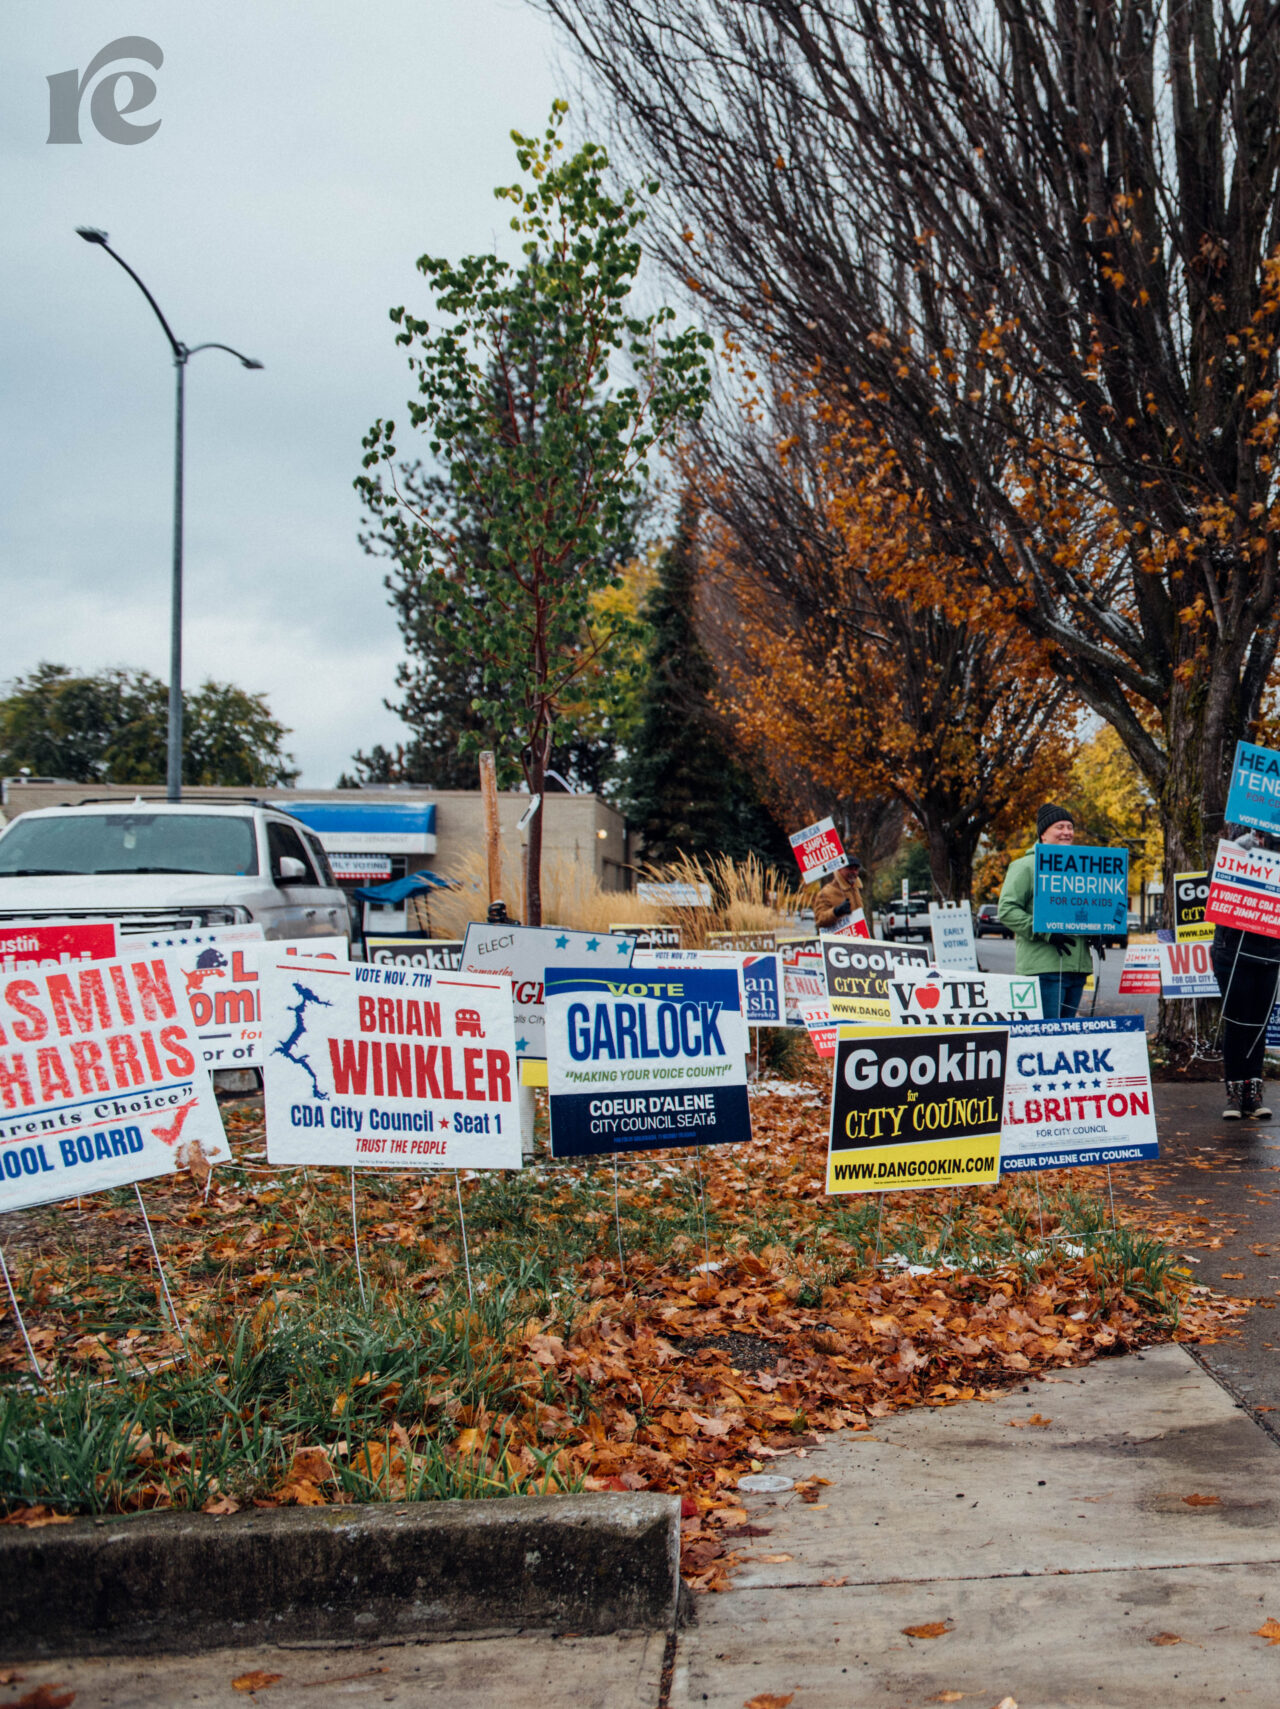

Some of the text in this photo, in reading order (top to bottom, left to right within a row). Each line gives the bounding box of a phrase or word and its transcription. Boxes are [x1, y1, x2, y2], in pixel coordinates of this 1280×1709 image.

[1246, 792, 1264, 804] FOR
[1239, 814, 1258, 826] VOTE
[803, 834, 829, 854] SAMPLE
[802, 843, 838, 869] BALLOTS
[1040, 853, 1124, 874] HEATHER
[1217, 855, 1274, 882] JIMMY
[1039, 874, 1124, 895] TENBRINK
[1050, 897, 1113, 907] FOR CDA KIDS
[1212, 890, 1218, 898] A
[1219, 891, 1241, 904] VOICE
[1242, 896, 1257, 908] FOR
[1258, 899, 1274, 912] CDA
[1210, 902, 1233, 916] ELECT
[1233, 906, 1260, 922] JIMMY
[943, 928, 964, 936] EARLY
[1046, 922, 1115, 931] VOTE NOVEMBER 7TH
[478, 934, 515, 955] ELECT
[943, 940, 968, 948] VOTING
[655, 952, 669, 960] VOTE
[355, 968, 432, 987] VOTE NOV. 7TH
[834, 976, 871, 995] CITY
[1172, 976, 1183, 984] FOR
[1198, 975, 1211, 983] CITY
[606, 983, 685, 997] VOTE
[0, 959, 177, 1046] SMIN
[358, 995, 442, 1038] BRIAN
[567, 1001, 727, 1062] GARLOCK
[1011, 1020, 1117, 1034] VOICE FOR THE PEOPLE
[232, 1044, 255, 1058] of
[0, 1025, 196, 1110] HARRIS
[327, 1037, 512, 1102] WINKLER
[844, 1042, 1001, 1090] Gookin
[1016, 1048, 1115, 1077] CLARK
[620, 1068, 650, 1081] YOUR
[652, 1066, 684, 1079] VOICE
[589, 1093, 715, 1116] COEUR D'ALENE
[907, 1090, 918, 1101] for
[290, 1104, 502, 1134] CDA City Council Seat 1
[590, 1119, 619, 1134] CITY
[620, 1116, 675, 1132] COUNCIL
[845, 1096, 998, 1139] CITY COUNCIL
[1036, 1125, 1108, 1137] FOR CITY COUNCIL
[59, 1125, 144, 1168] BOARD
[356, 1138, 447, 1155] TRUST THE PEOPLE
[834, 1157, 995, 1180] WWW.DANGOOKIN.COM
[1003, 1149, 1143, 1169] COEUR D'ALENE CITY COUNCIL
